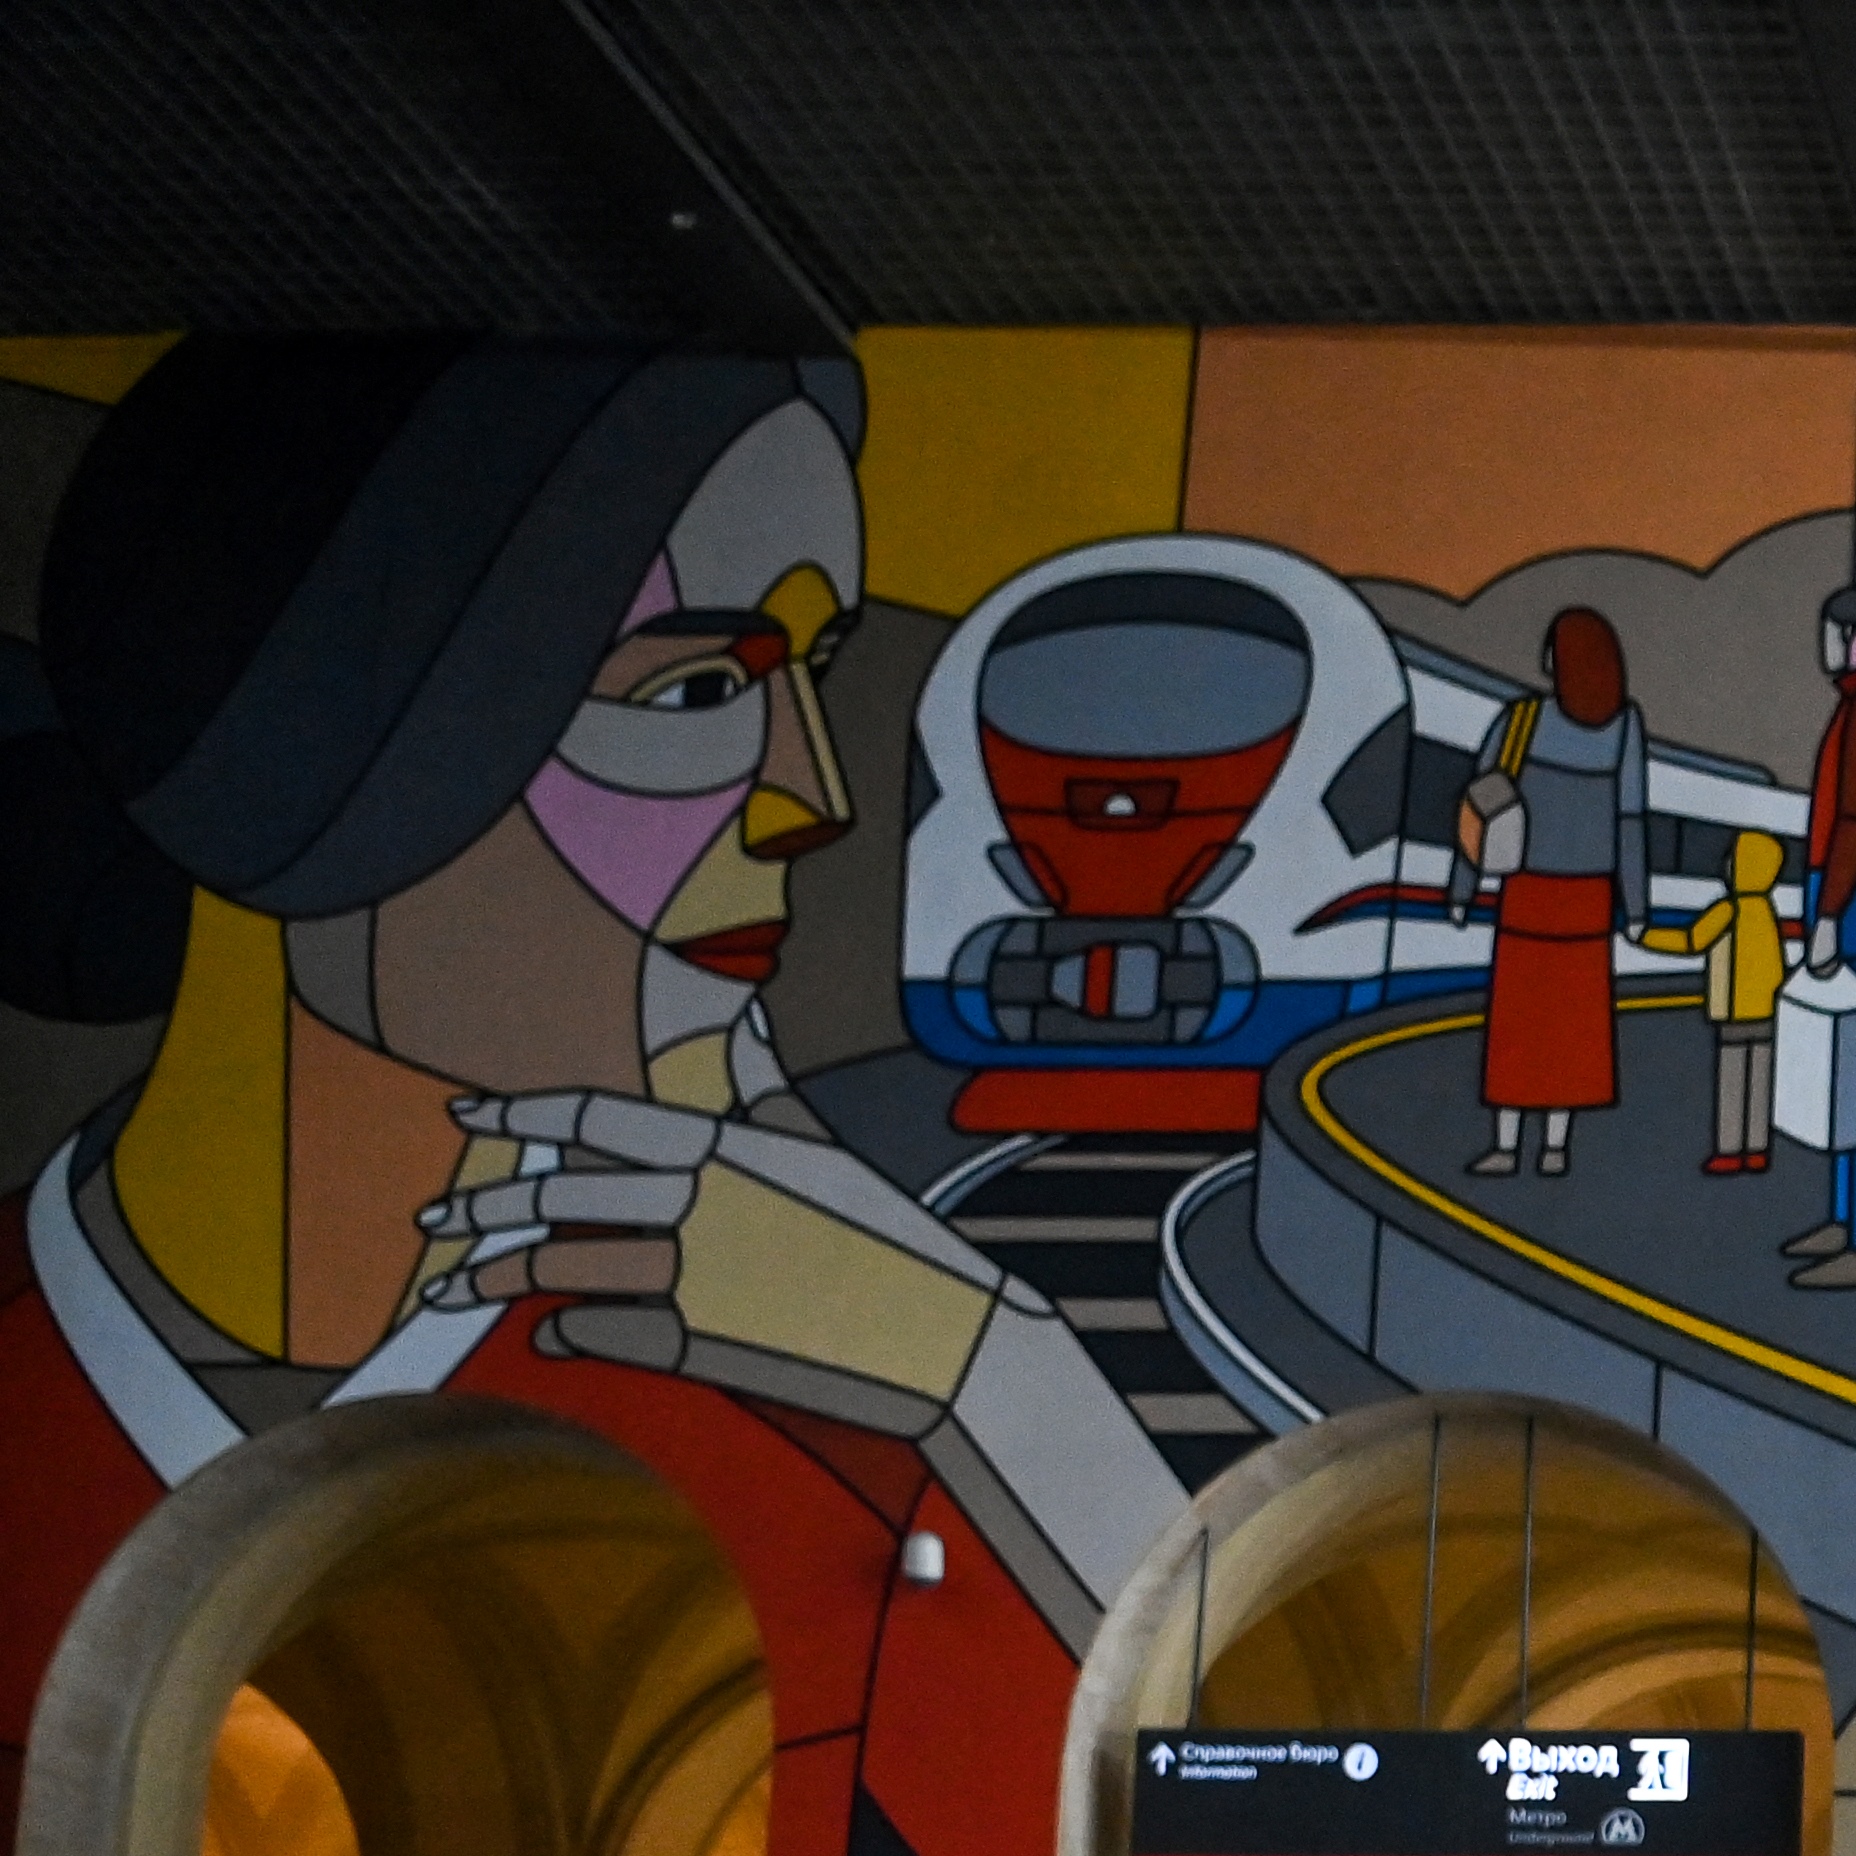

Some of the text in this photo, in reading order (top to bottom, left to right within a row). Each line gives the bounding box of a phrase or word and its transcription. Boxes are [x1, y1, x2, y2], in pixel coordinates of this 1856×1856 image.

[1289, 1740, 1340, 1766] бюро
[1508, 1737, 1620, 1778] Выход
[1506, 1772, 1559, 1801] Exit
[1508, 1806, 1568, 1828] Метро
